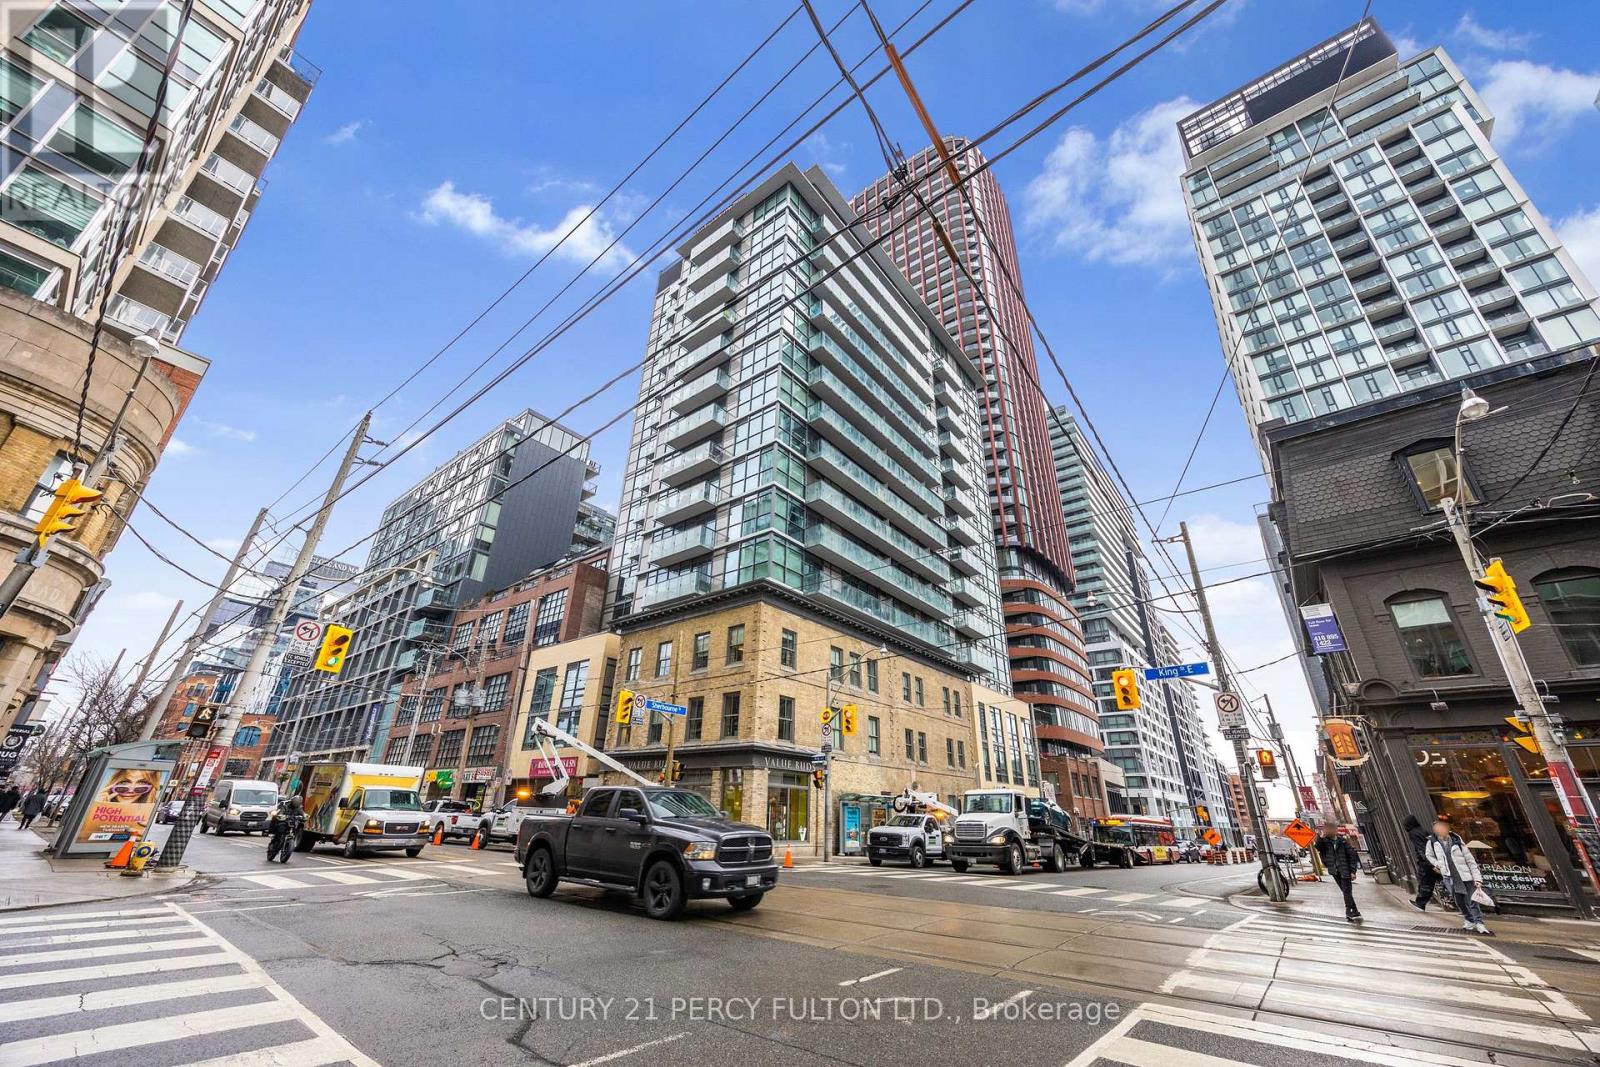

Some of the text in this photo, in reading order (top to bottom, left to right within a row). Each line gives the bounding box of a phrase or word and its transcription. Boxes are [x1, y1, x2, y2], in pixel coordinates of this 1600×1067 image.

[1158, 668, 1178, 678] King
[1187, 665, 1194, 674] E
[651, 702, 678, 713] Sherbourne
[628, 760, 651, 769] VALUE
[764, 757, 816, 772] VALUE BUDS
[95, 806, 122, 815] HIGH
[92, 814, 145, 822] POTENTIAL
[1480, 872, 1547, 885] terior design
